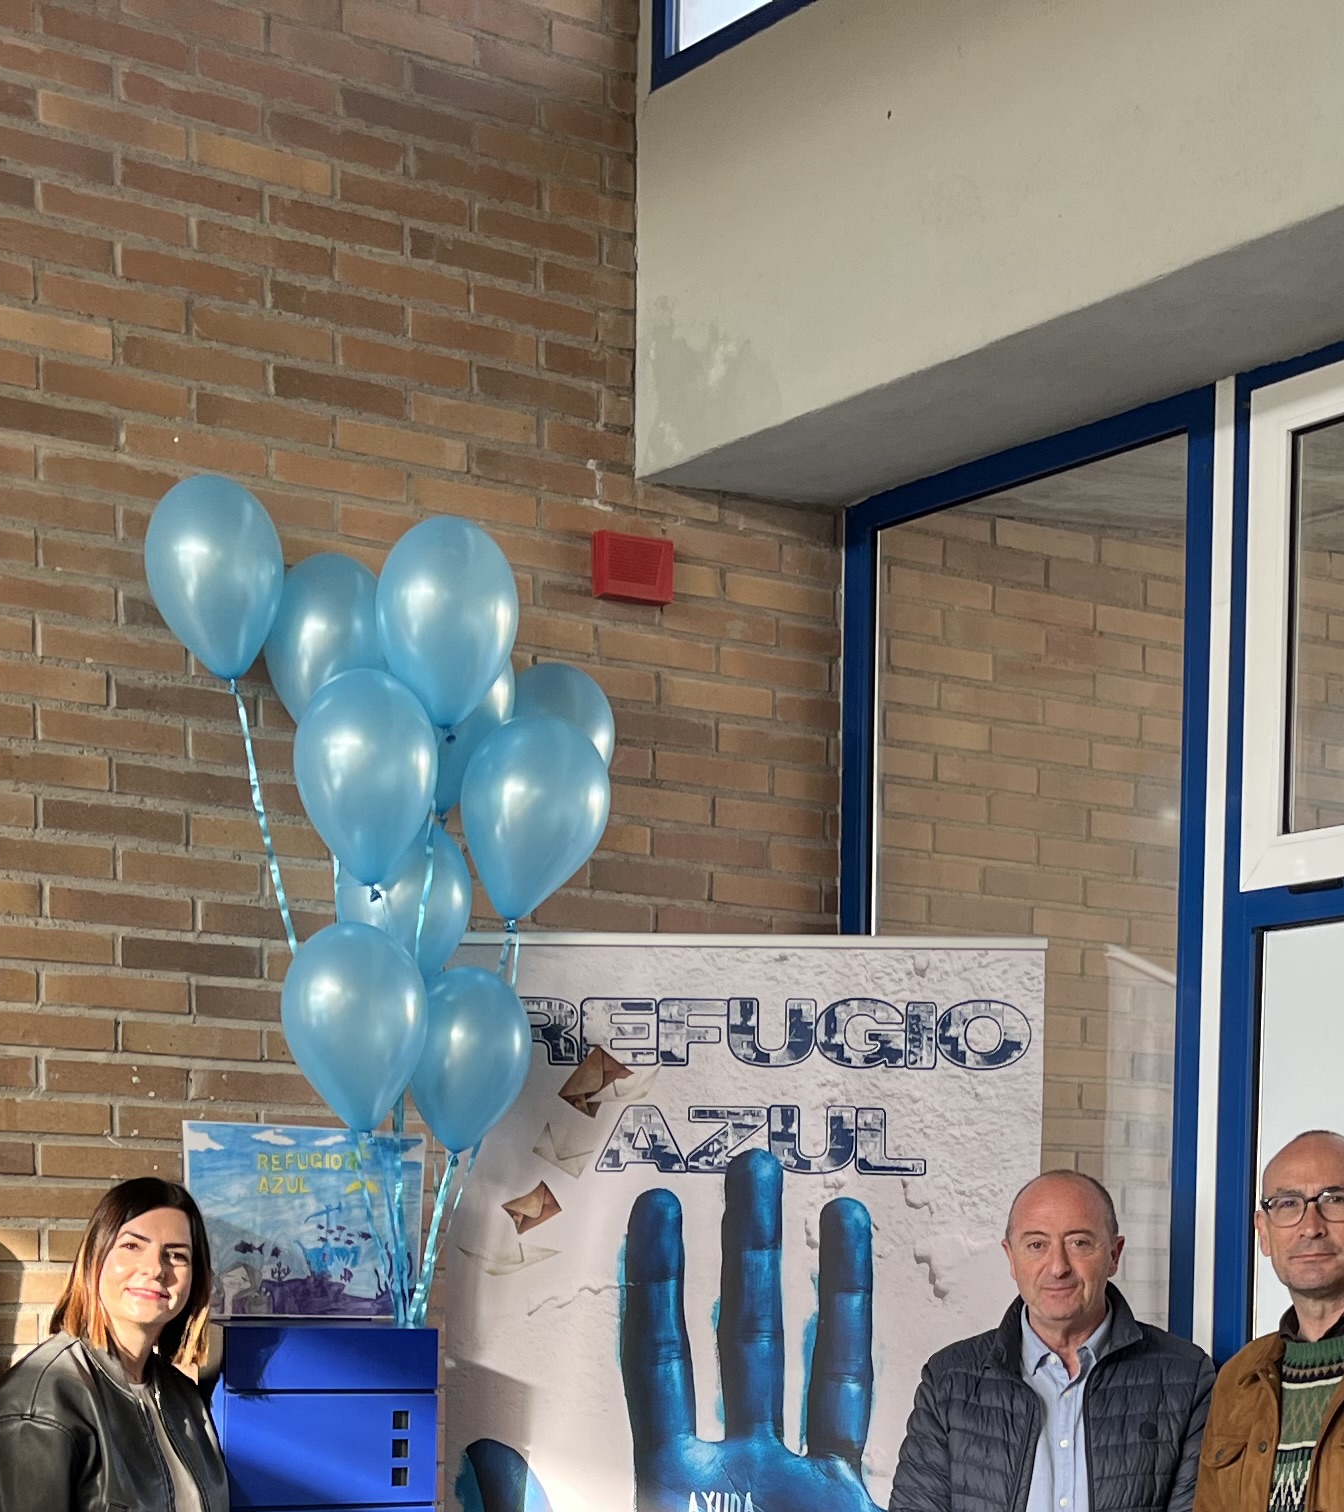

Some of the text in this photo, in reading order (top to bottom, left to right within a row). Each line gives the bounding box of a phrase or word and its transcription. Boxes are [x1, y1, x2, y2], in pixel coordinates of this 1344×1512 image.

[519, 996, 1032, 1071] REFUGIO
[257, 1151, 344, 1171] REFUGIO
[595, 1105, 926, 1176] AZUL
[257, 1176, 310, 1195] AZUL
